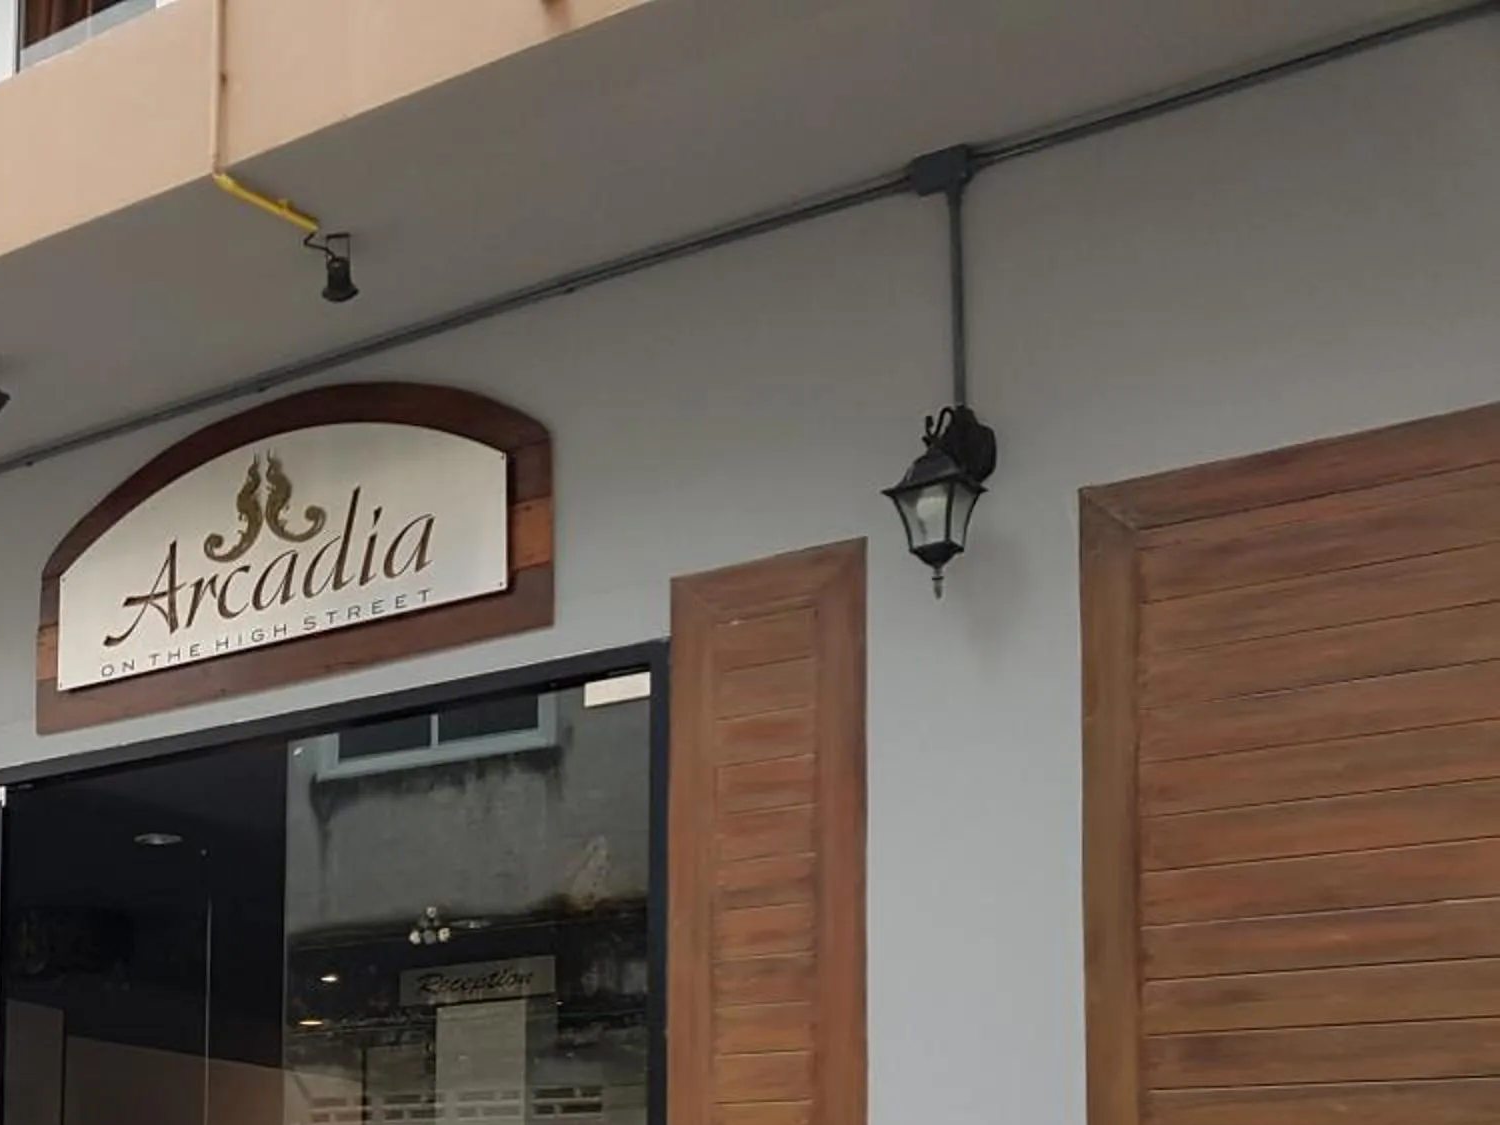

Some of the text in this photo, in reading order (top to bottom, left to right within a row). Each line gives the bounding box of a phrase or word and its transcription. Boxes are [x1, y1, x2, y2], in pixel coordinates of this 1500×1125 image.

[103, 485, 437, 647] Arcadia
[101, 588, 432, 677] ON THE HIGH STREET
[417, 968, 533, 995] Reception
